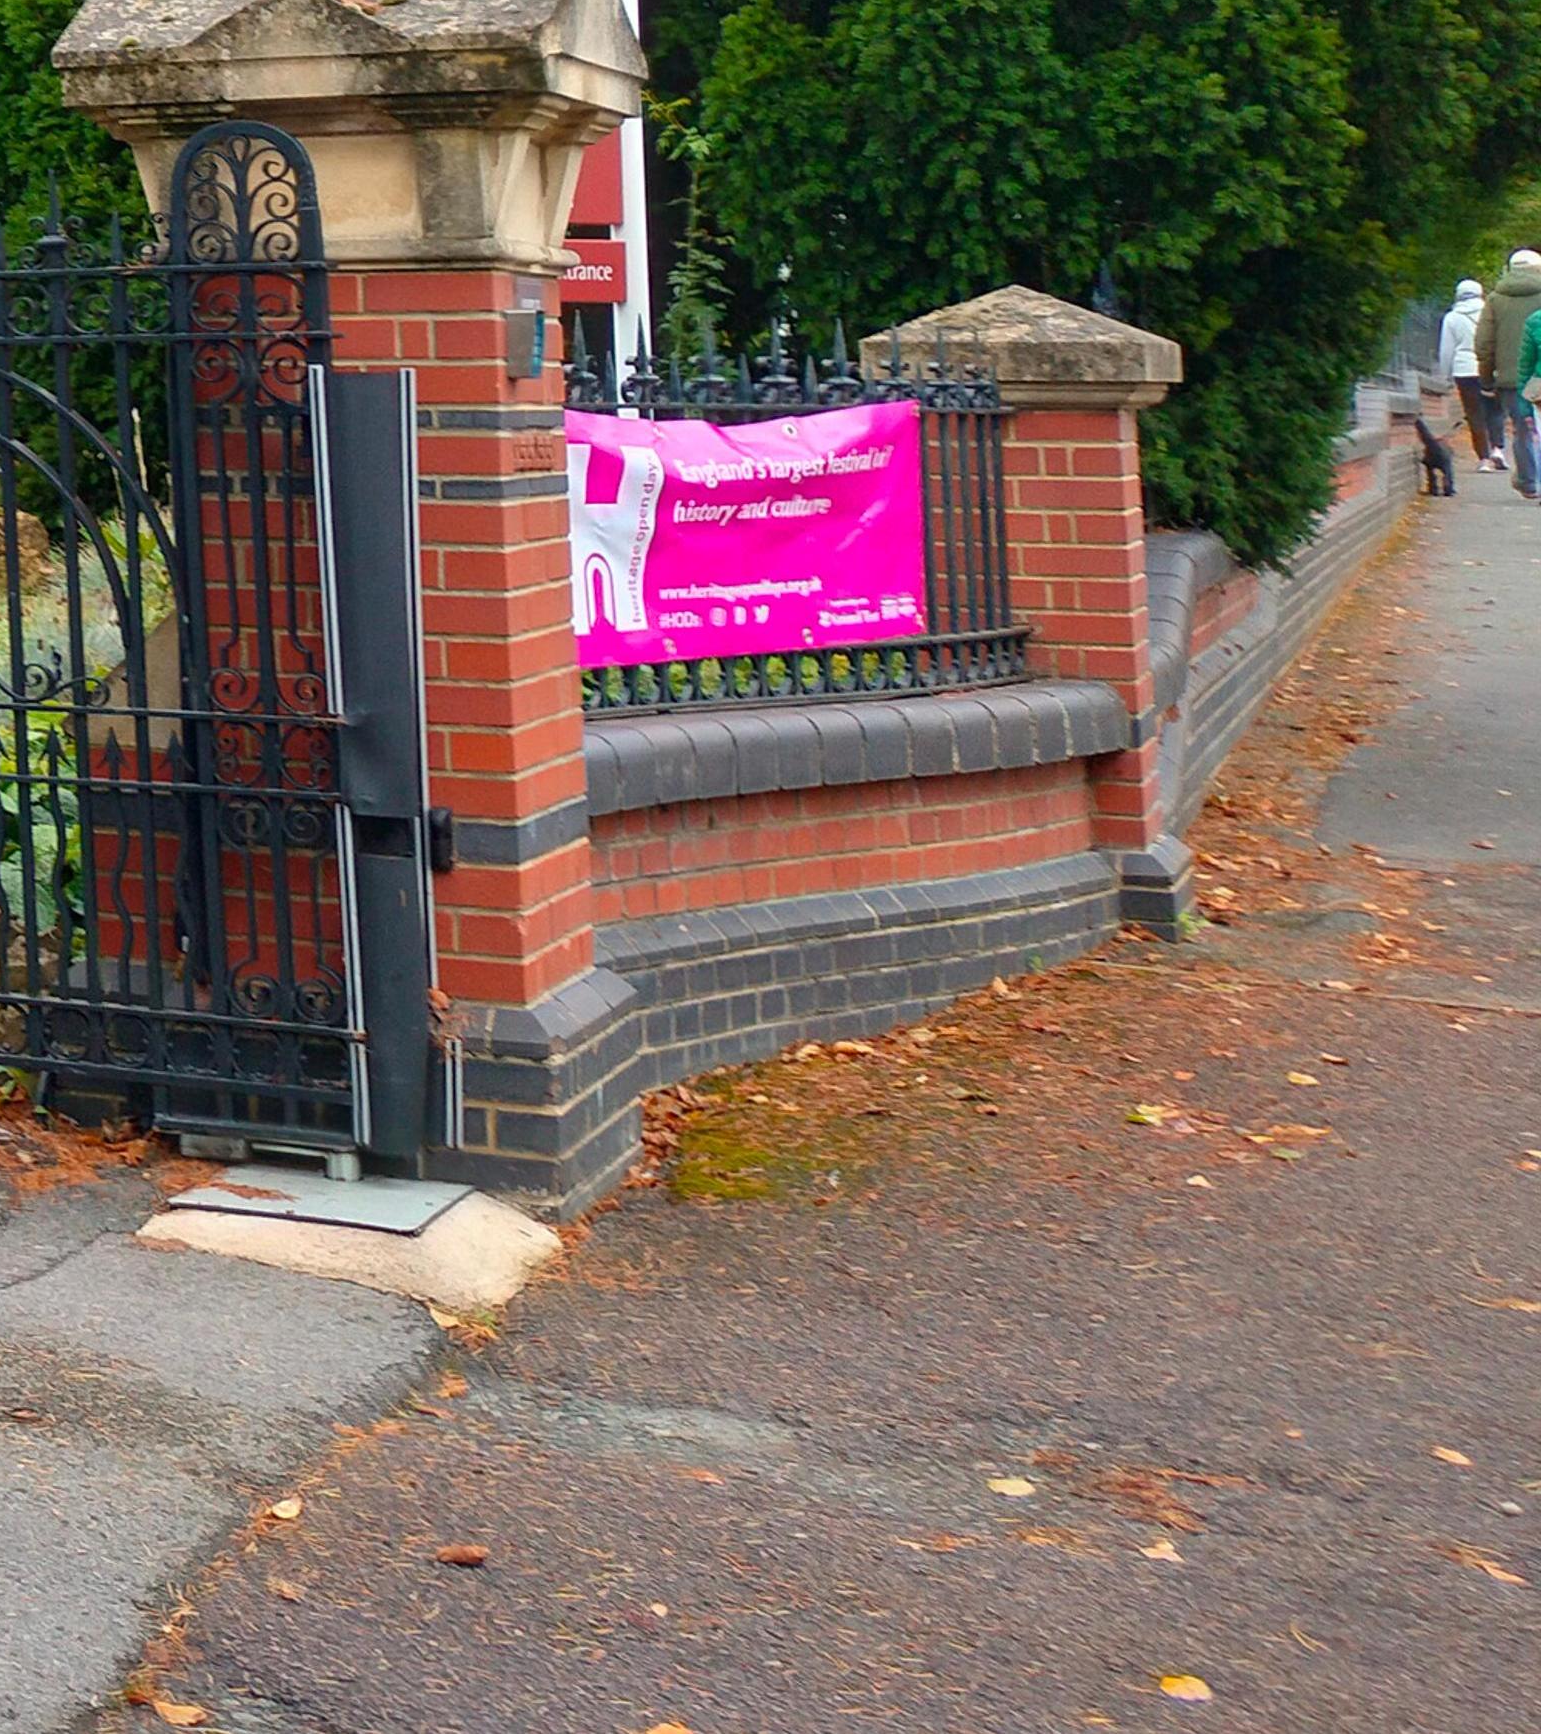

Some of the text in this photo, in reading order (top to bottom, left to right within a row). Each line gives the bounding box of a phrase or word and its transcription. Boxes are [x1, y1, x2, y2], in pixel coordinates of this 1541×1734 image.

[557, 264, 614, 282] trance
[642, 455, 660, 494] day
[635, 497, 651, 543] open
[673, 499, 737, 526] history
[737, 495, 773, 520] and
